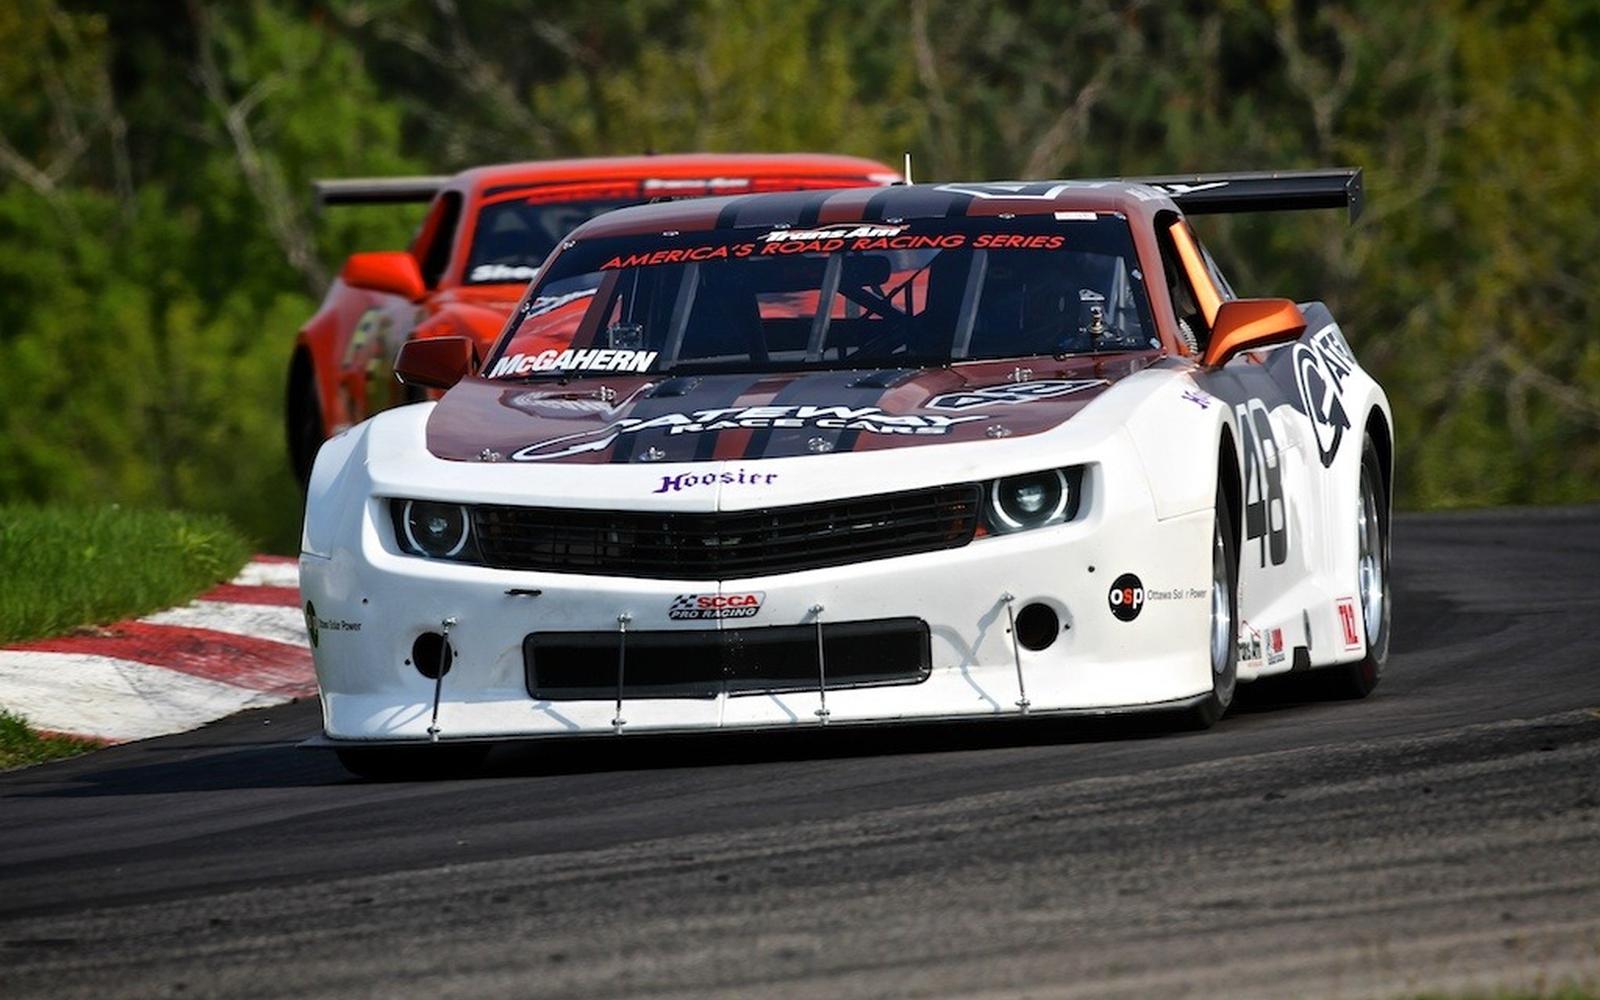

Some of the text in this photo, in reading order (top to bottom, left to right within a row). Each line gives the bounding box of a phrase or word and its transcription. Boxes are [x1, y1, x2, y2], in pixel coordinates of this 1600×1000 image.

[764, 226, 902, 242] Trans Am
[600, 235, 1065, 270] AMERICA'S ROAD RACING SERIES
[488, 349, 658, 379] McGAHERN
[670, 418, 951, 435] RACE CARS
[653, 468, 778, 494] Hoosier
[1238, 402, 1288, 567] 48
[696, 595, 758, 607] SCCA
[1110, 588, 1143, 609] osp
[671, 607, 756, 619] PRO RACING
